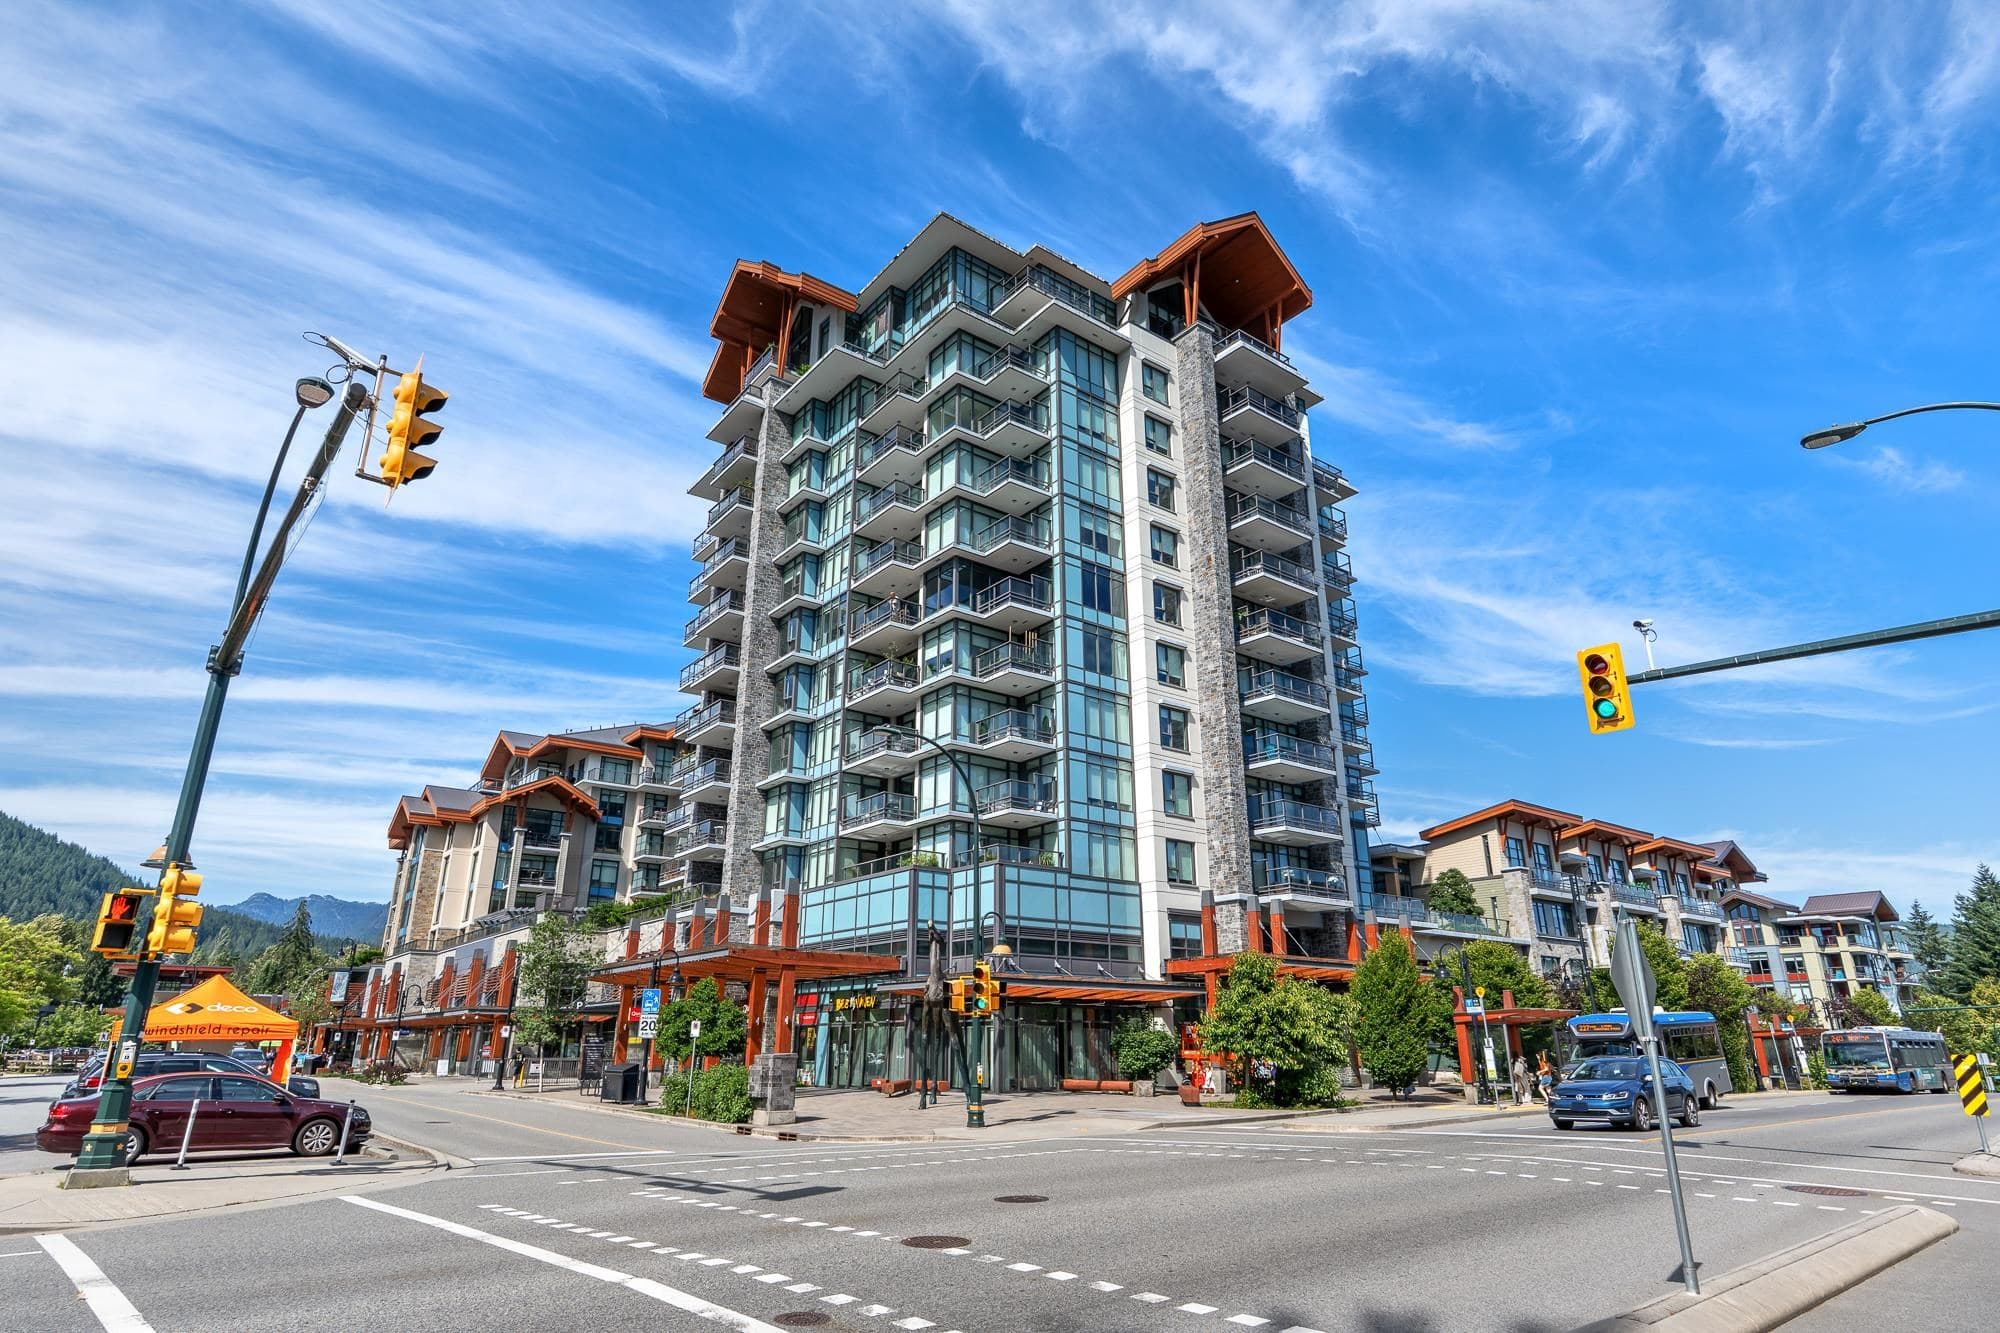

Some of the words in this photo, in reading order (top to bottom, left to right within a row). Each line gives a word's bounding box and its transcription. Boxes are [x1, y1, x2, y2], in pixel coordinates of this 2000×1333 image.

[207, 1002, 258, 1013] deco
[145, 1024, 223, 1036] windshield
[227, 1025, 272, 1036] repair
[640, 1020, 657, 1031] 20
